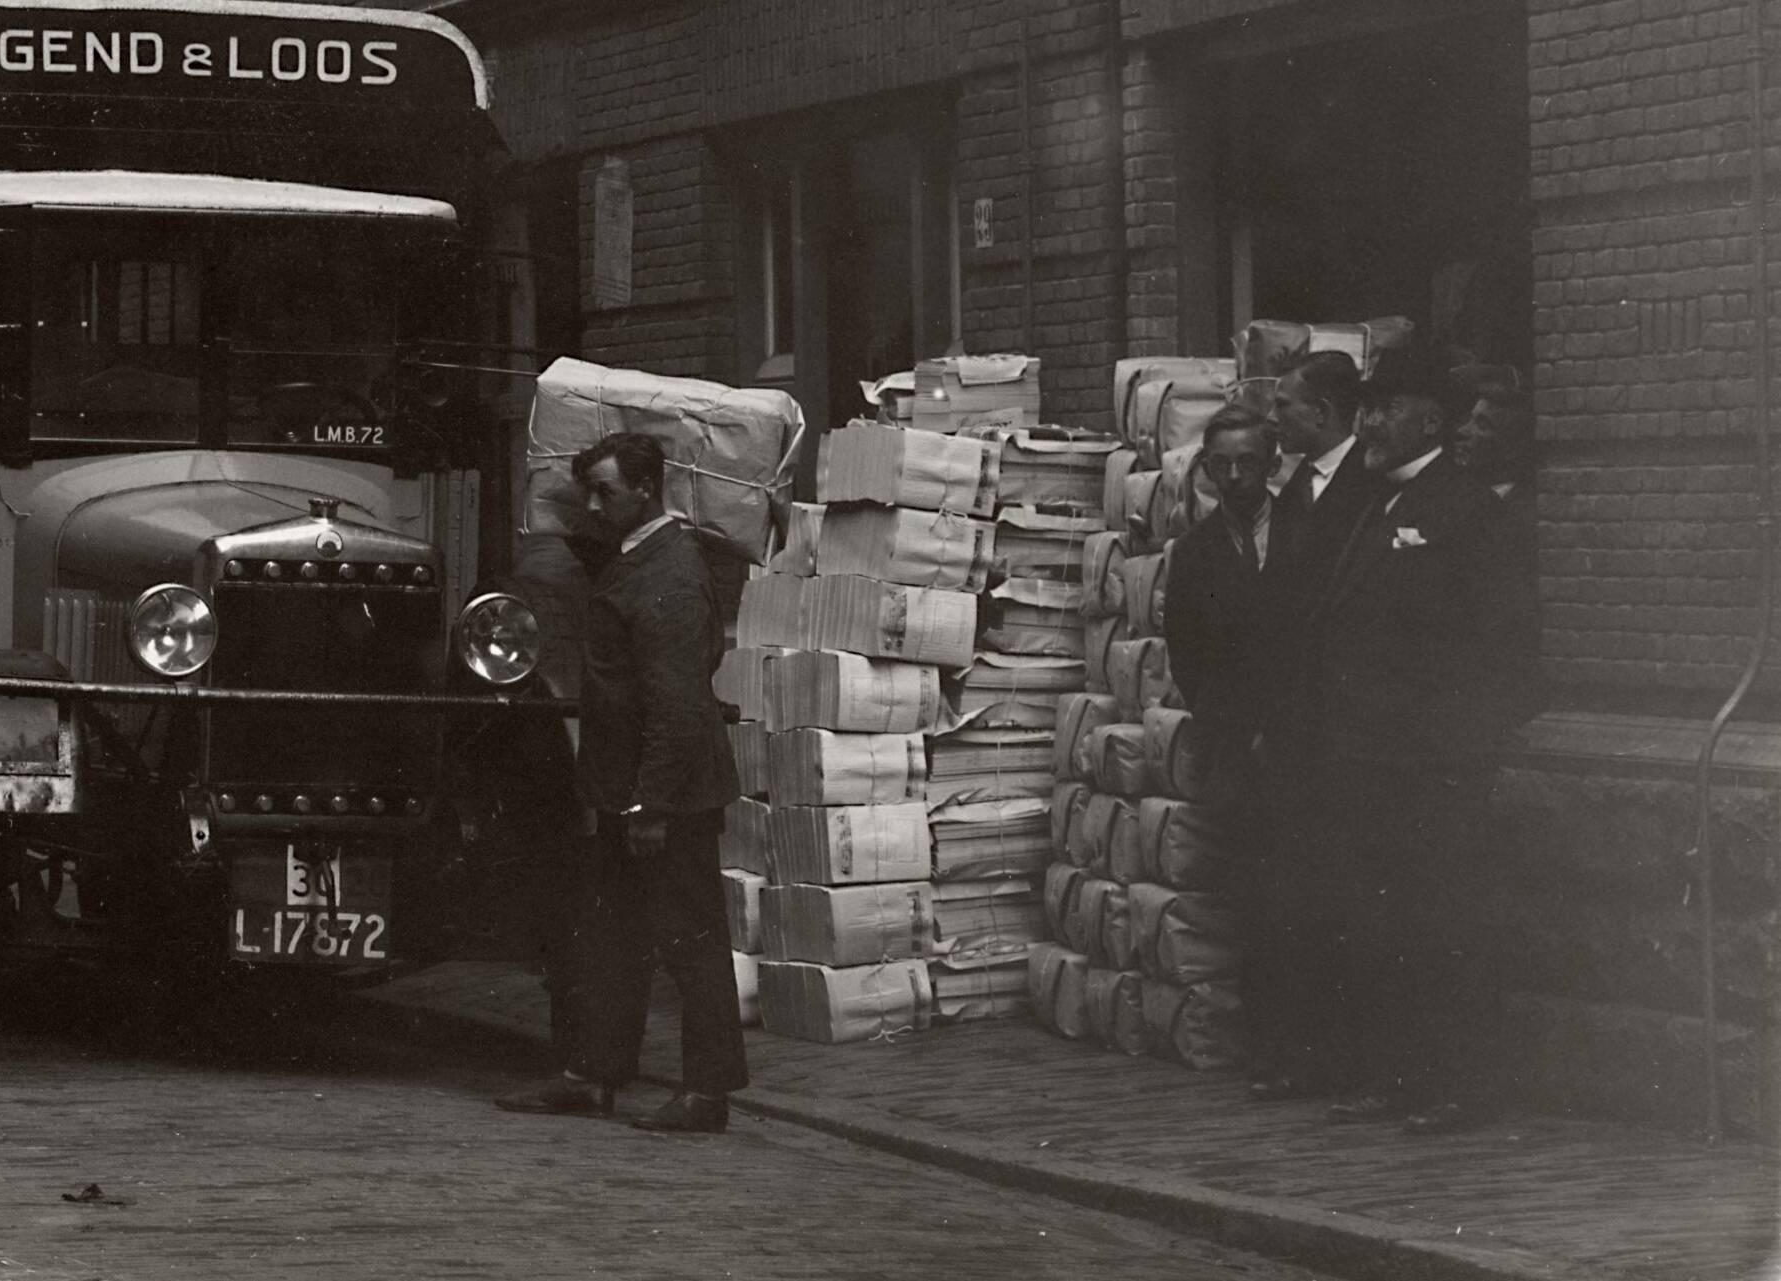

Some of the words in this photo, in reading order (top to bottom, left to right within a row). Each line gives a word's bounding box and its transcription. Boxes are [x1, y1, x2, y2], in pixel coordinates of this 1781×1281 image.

[182, 43, 212, 77] &
[228, 36, 397, 85] LOOS
[235, 908, 386, 959] L-17872
